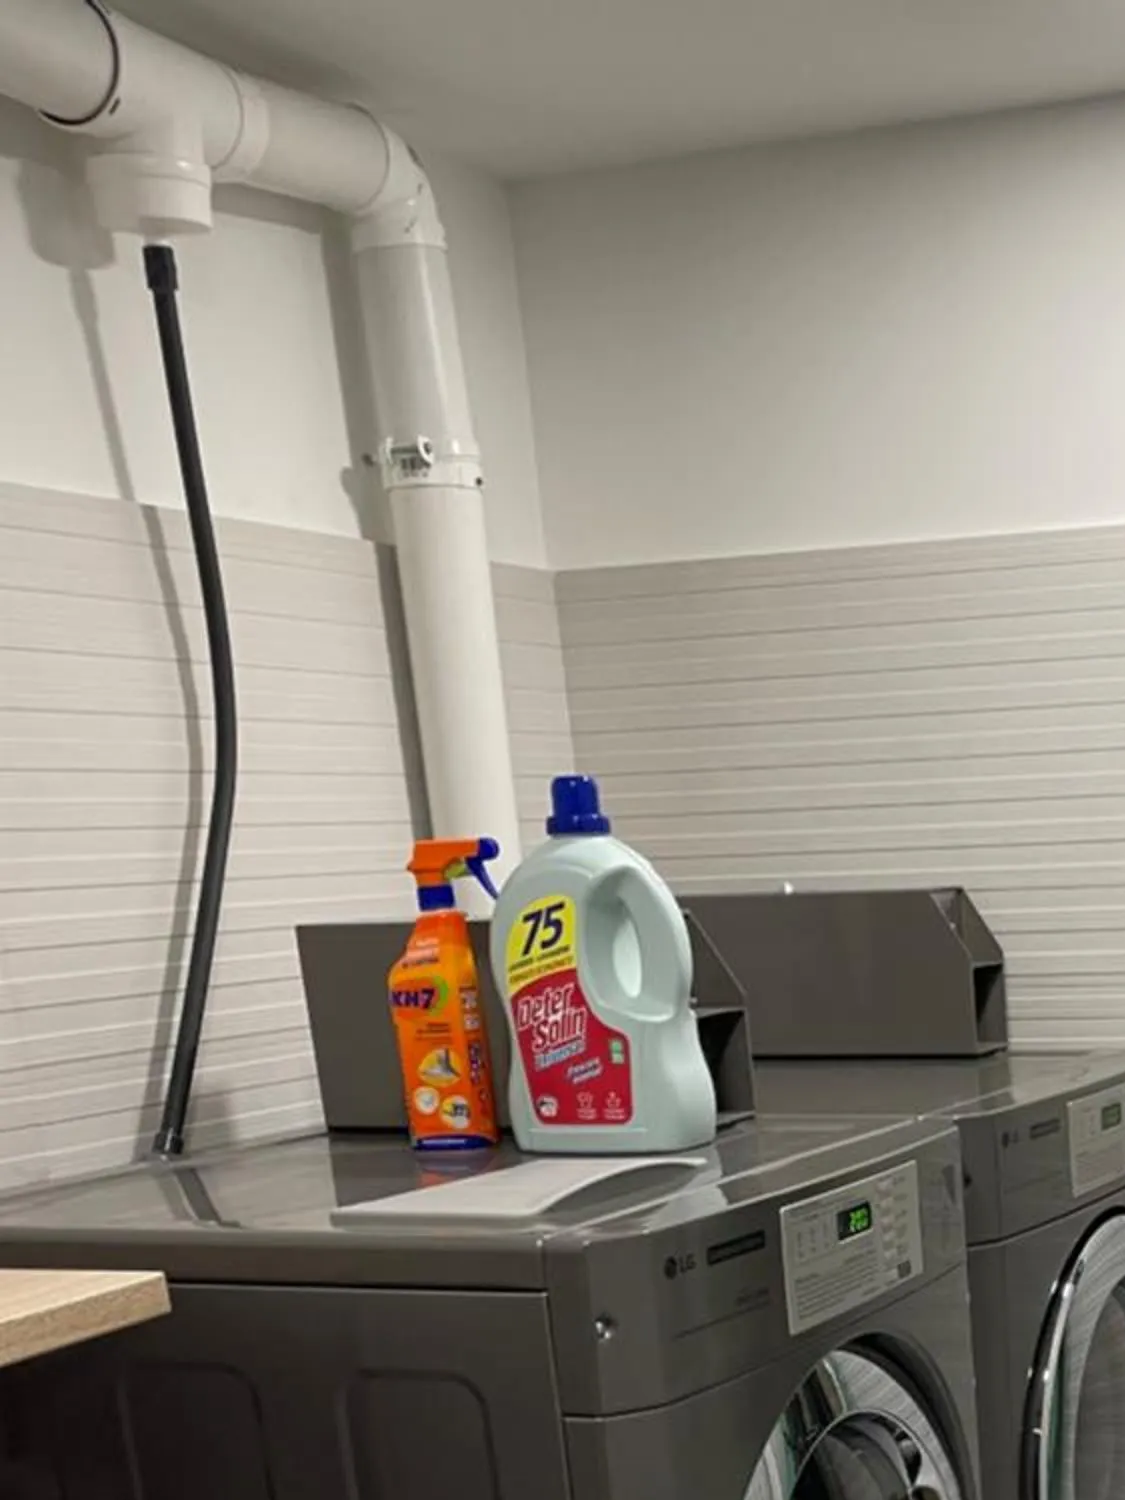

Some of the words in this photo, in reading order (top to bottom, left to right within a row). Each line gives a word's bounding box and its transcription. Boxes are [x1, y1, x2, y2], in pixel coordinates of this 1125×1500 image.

[522, 902, 565, 956] 75
[391, 988, 435, 1009] KH7
[518, 983, 575, 1032] Deter
[532, 1006, 587, 1053] Solin
